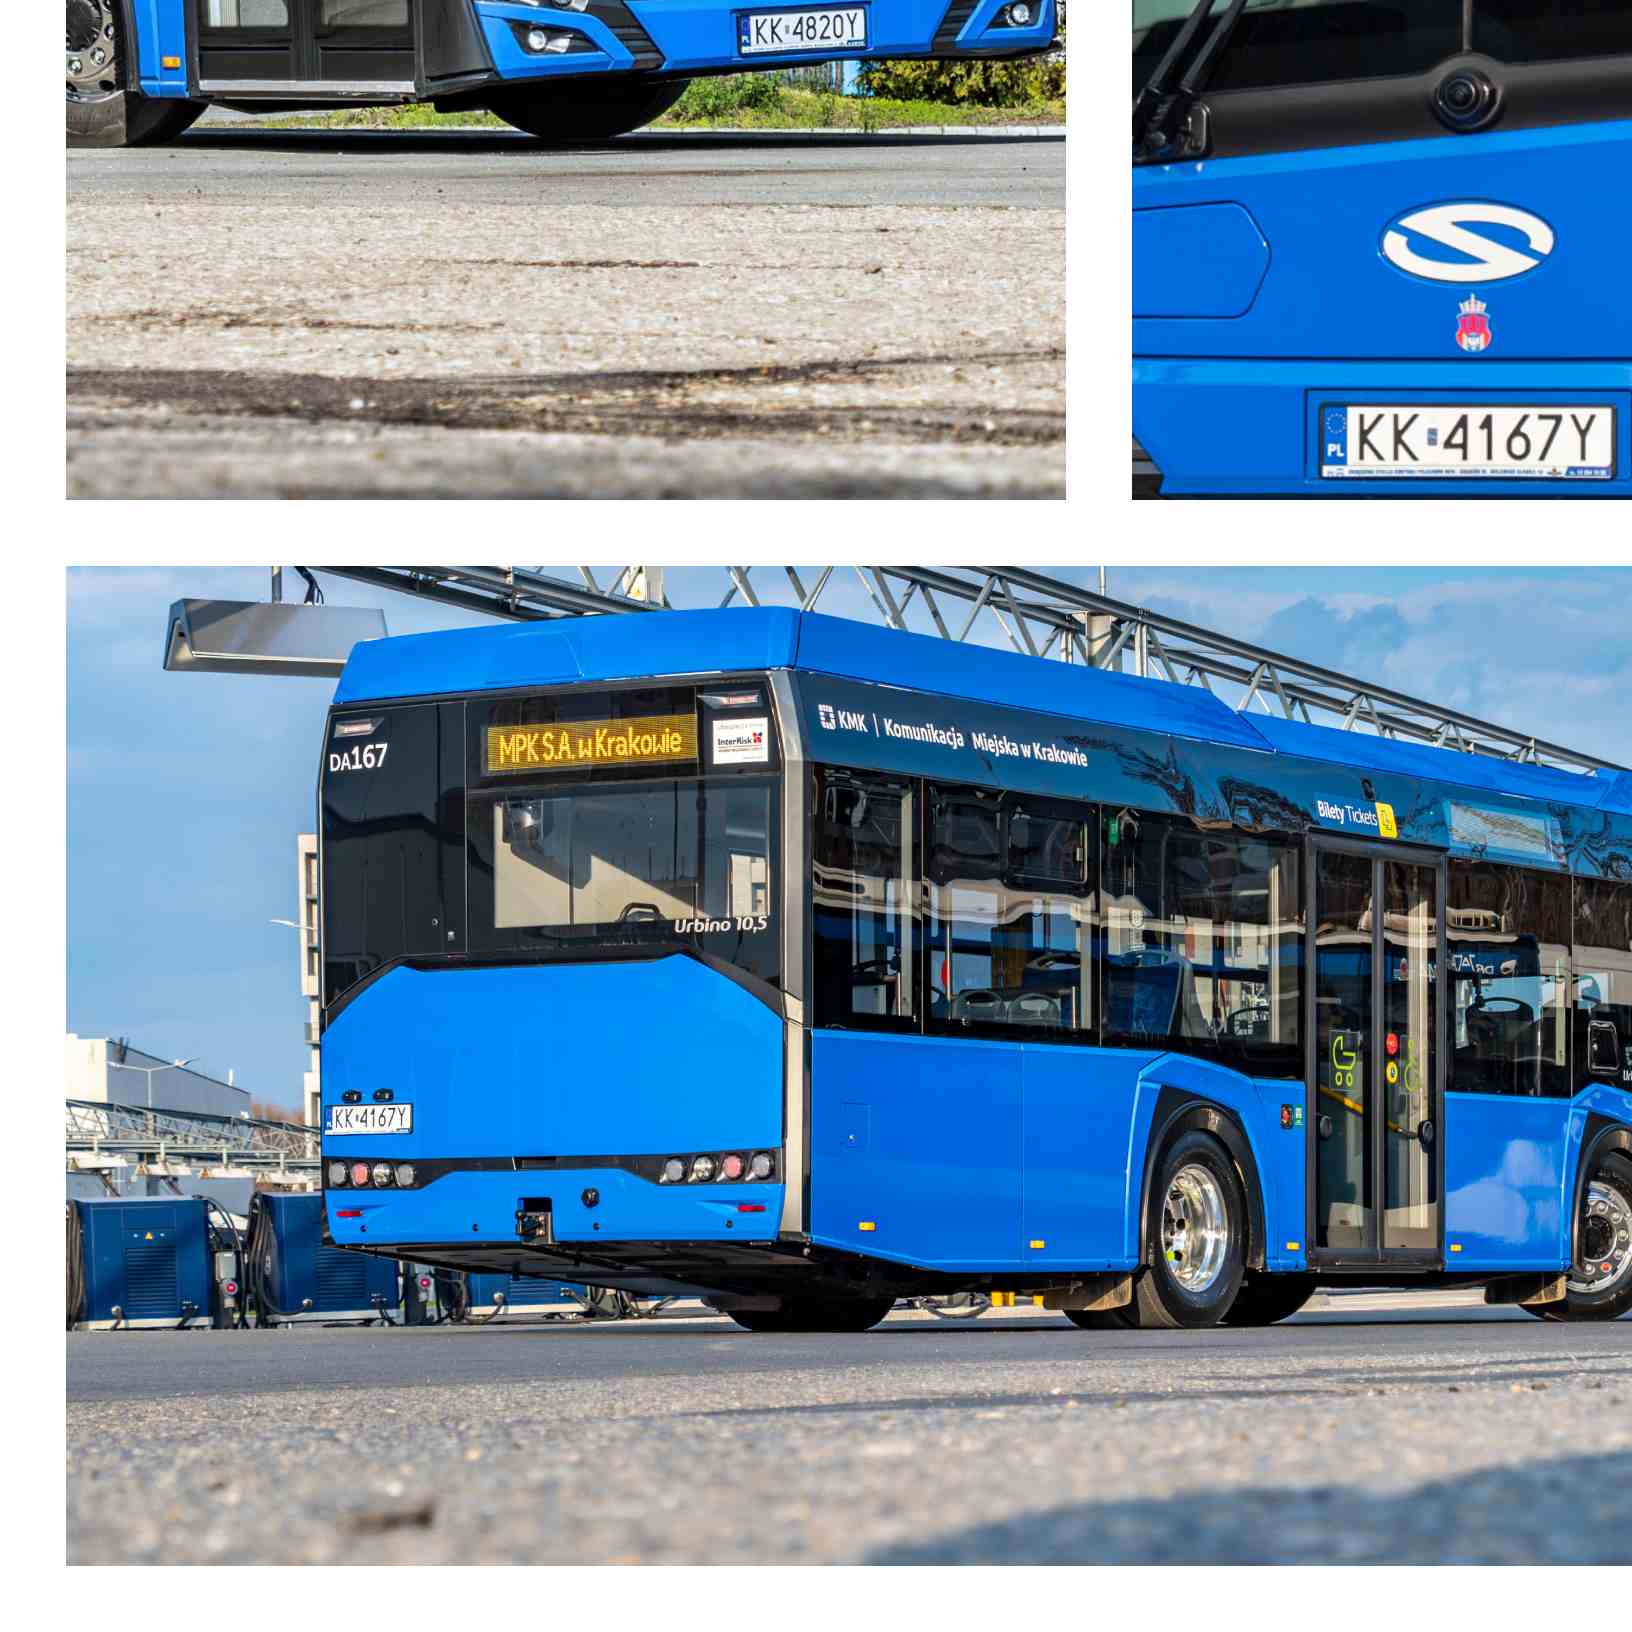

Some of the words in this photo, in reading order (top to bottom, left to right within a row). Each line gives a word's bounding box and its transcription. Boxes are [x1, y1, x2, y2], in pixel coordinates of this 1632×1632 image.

[755, 16, 783, 45] KK
[792, 12, 858, 41] 4820Y
[1327, 443, 1345, 458] PL
[1358, 413, 1420, 462] KK
[1443, 413, 1597, 462] 4167Y
[499, 731, 539, 764] MPK
[543, 730, 575, 760] S.A.
[595, 726, 683, 759] Krakowie
[838, 710, 868, 734] KMK
[883, 718, 965, 751] Komunikacja
[972, 732, 1019, 758] Miejska
[1021, 743, 1031, 759] w
[1032, 741, 1089, 768] Krakowie
[329, 742, 388, 772] DA167
[1317, 800, 1345, 825] Bilety
[1344, 805, 1378, 827] Tickets
[674, 918, 732, 934] Urbino
[735, 915, 768, 935] 10,5
[335, 1108, 354, 1129] KK
[359, 1106, 406, 1128] 4167Y
